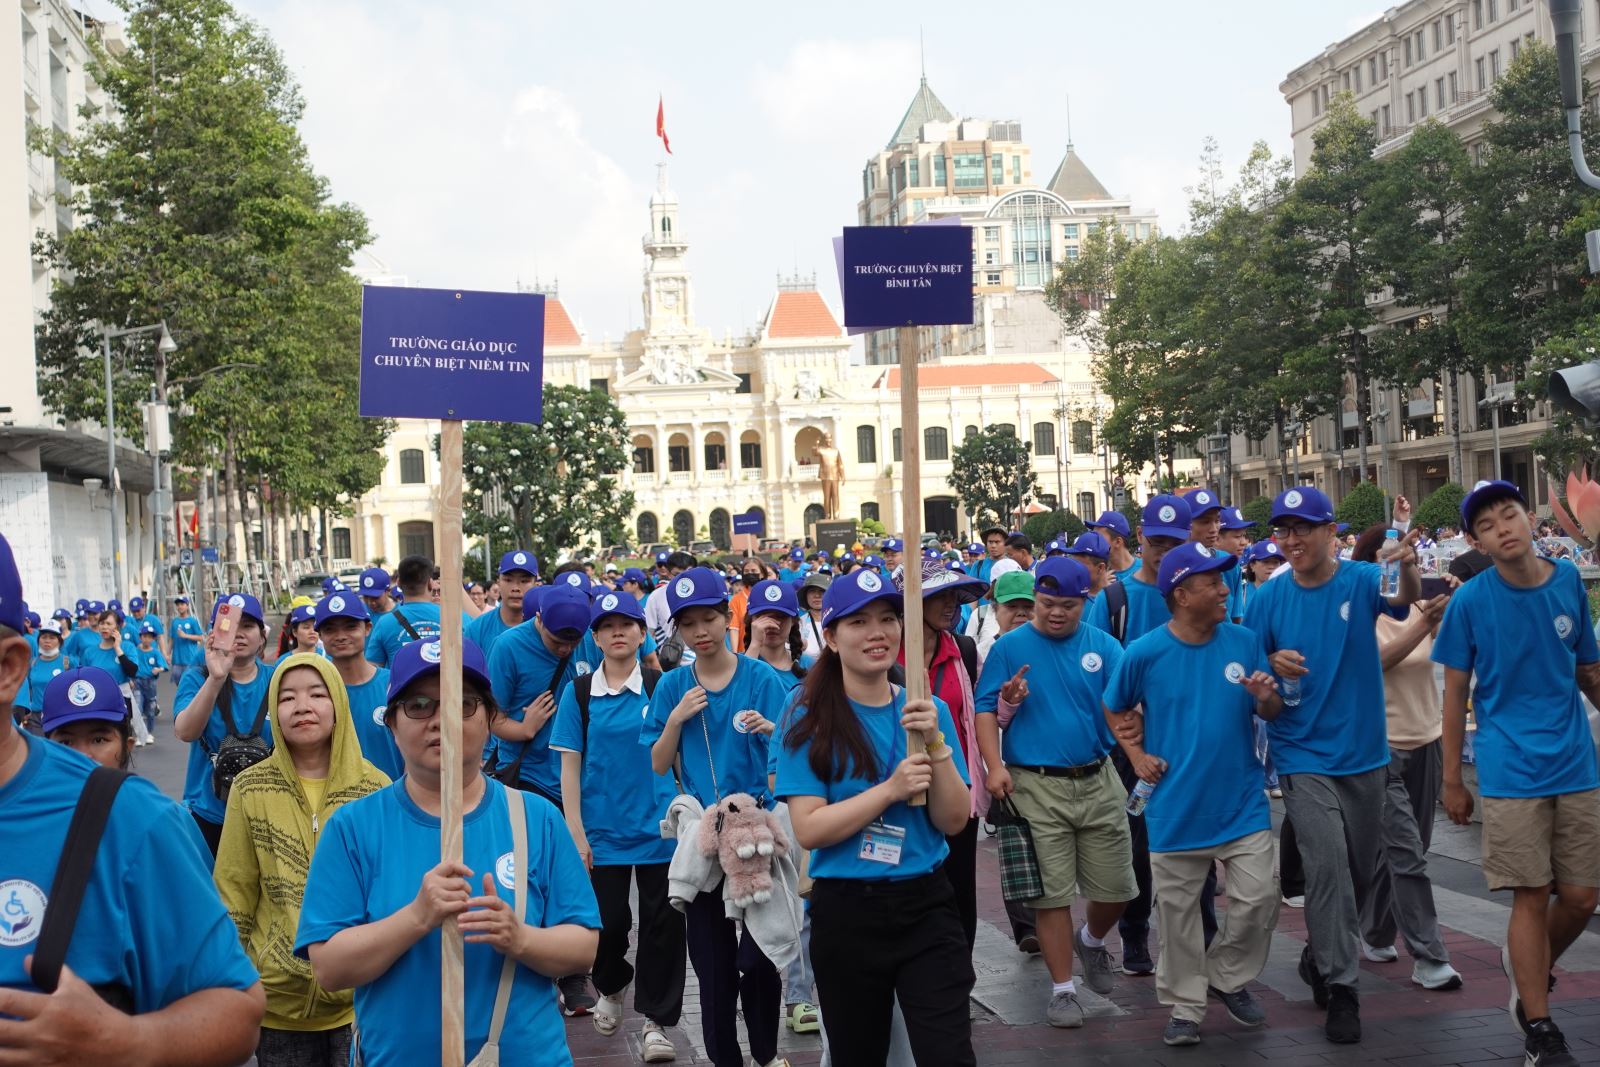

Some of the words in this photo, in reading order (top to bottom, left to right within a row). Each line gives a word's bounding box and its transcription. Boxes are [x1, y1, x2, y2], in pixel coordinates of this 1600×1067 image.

[854, 263, 896, 274] TRƯỜNG
[898, 263, 938, 273] CHUYÊN
[941, 264, 963, 274] BIỆT
[886, 277, 909, 288] BÌNH
[912, 277, 932, 288] TÂN
[390, 336, 448, 350] TRƯỜNG
[451, 338, 486, 352] GIÁO
[489, 342, 517, 355] DỤC
[374, 354, 431, 367] CHUYÊN
[435, 356, 466, 371] BIỆT
[469, 357, 504, 371] NIỀM
[507, 361, 530, 372] TIN
